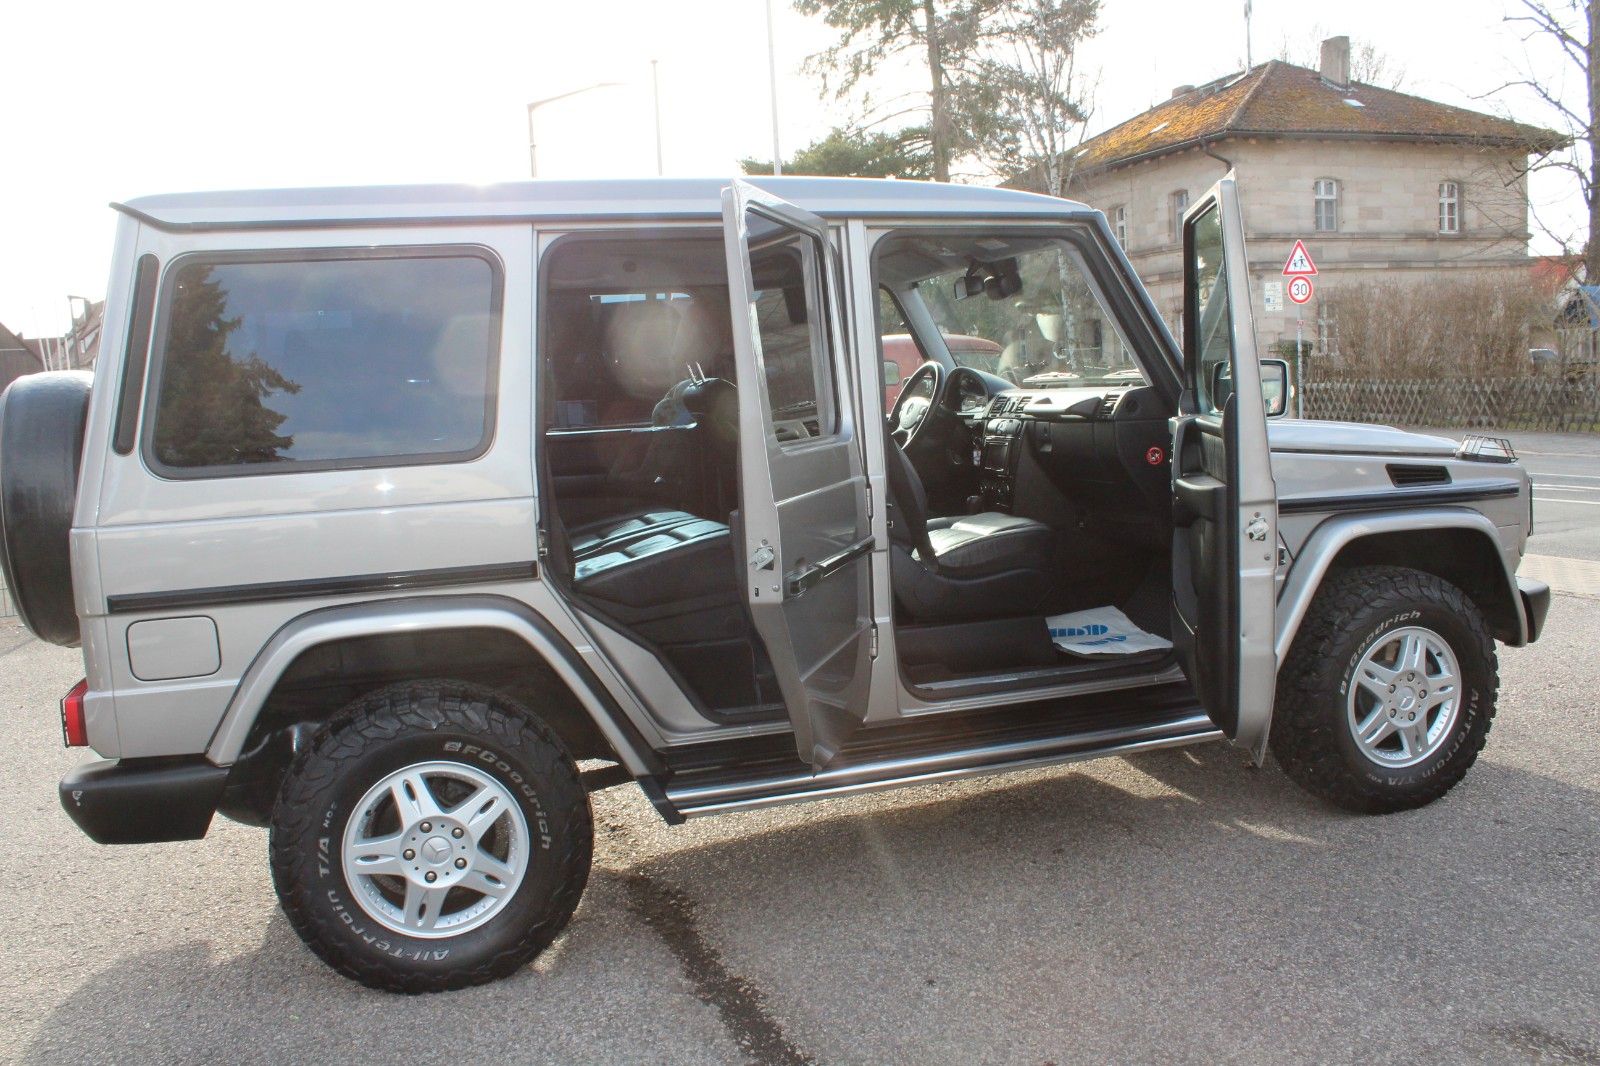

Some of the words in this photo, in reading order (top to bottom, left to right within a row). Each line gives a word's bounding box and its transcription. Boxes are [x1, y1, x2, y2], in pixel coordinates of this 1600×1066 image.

[1293, 283, 1307, 296] 30
[1340, 610, 1422, 696] BFGoodrich
[443, 741, 552, 849] BFGoodrich
[318, 836, 331, 878] T/A
[327, 889, 450, 961] All-Terrain
